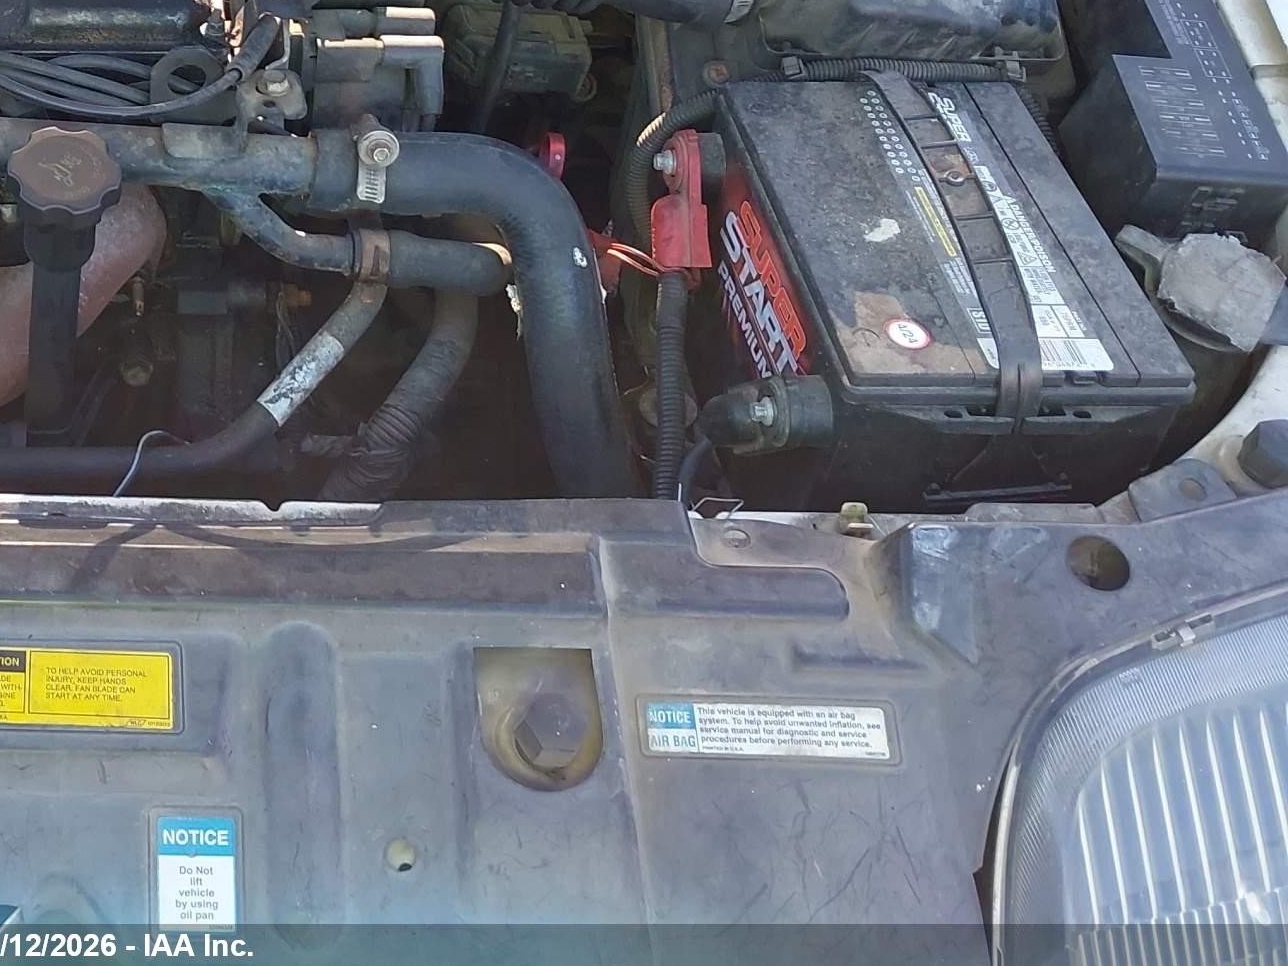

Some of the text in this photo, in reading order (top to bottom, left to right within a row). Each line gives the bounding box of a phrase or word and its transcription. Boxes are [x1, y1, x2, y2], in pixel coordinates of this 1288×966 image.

[740, 200, 807, 362] SUPER
[720, 210, 799, 375] START
[81, 668, 104, 676] AVOID
[106, 669, 148, 678] PERSONAL
[77, 676, 98, 684] KEEP
[100, 677, 126, 685] HANDS
[75, 684, 136, 694] FAN BLADE CAN
[72, 692, 81, 700] AT
[649, 710, 692, 723] NOTICE
[718, 708, 746, 716] vehicle
[748, 708, 755, 716] is
[757, 710, 794, 718] equipped
[840, 712, 856, 721] bag
[698, 717, 730, 726] system.
[744, 718, 762, 727] help
[764, 718, 786, 726] avoid
[788, 720, 827, 728] unwanted
[829, 721, 864, 730] inflation,
[731, 726, 760, 734] manual
[776, 728, 818, 737] diagnostic
[651, 734, 696, 747] AIR BAG
[701, 736, 872, 748] procedures before performing any service.
[162, 829, 229, 846] NOTICE
[180, 866, 214, 875] Do Not
[190, 877, 202, 886] lift
[178, 889, 215, 898] vehicle
[175, 900, 218, 911] by using
[180, 910, 214, 922] oil pan
